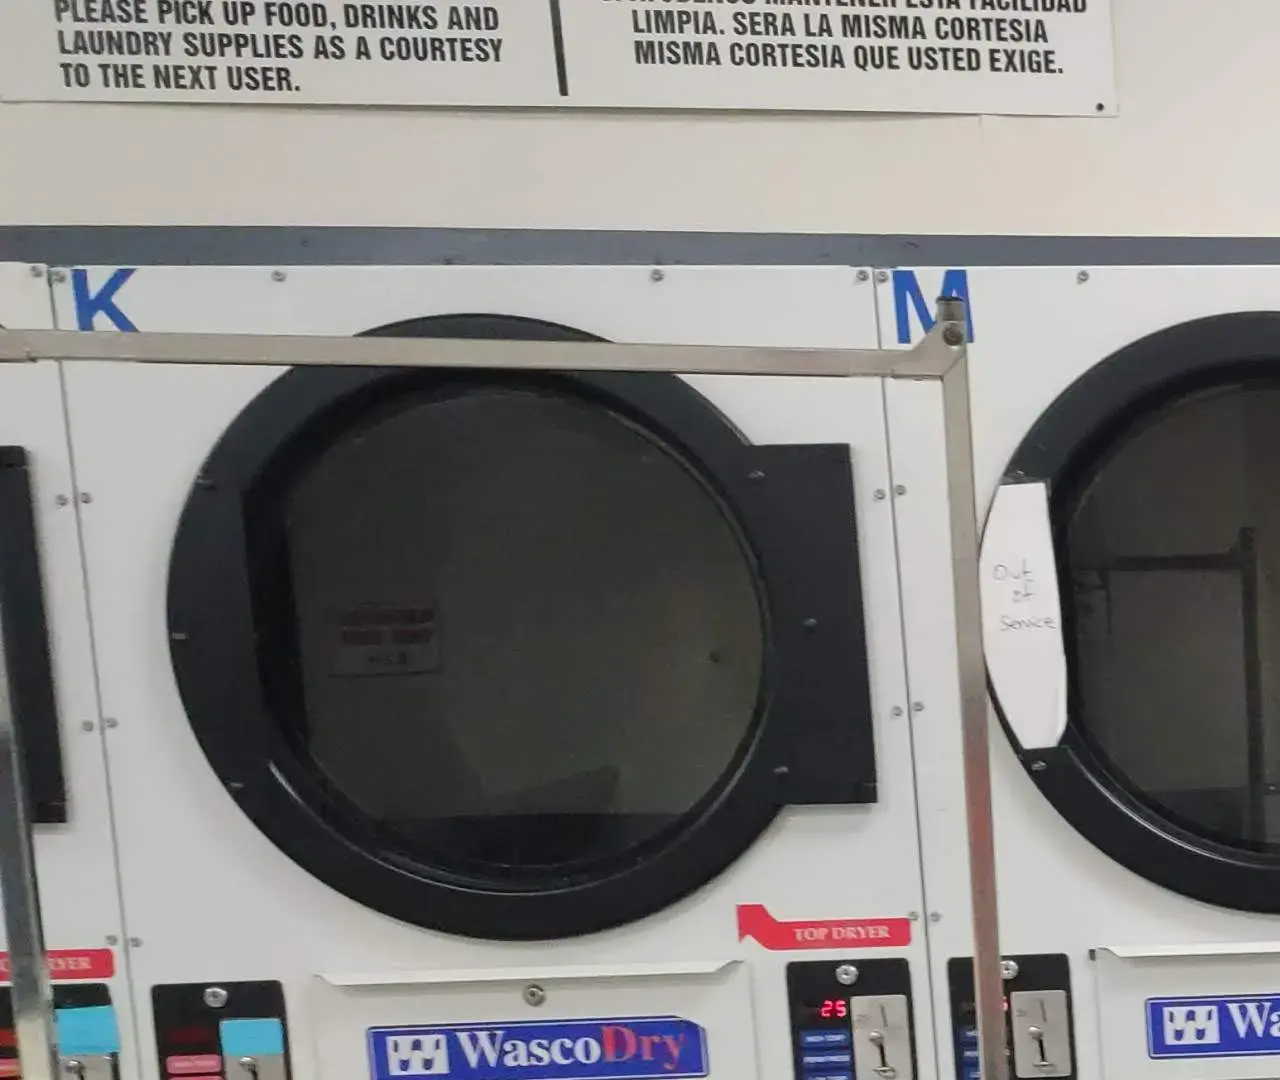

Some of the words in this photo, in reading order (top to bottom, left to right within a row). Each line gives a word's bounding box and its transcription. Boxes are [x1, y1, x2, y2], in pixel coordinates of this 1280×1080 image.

[54, 0, 148, 23] PLEASE
[157, 0, 215, 24] PICK
[222, 1, 256, 25] UP
[263, 2, 337, 30] FOOD,
[343, 4, 438, 29] DRINKS
[448, 6, 499, 30] AND
[632, 9, 725, 35] LIMPIA.
[732, 12, 796, 36] SERA
[804, 13, 833, 37] LA
[841, 15, 927, 40] MISMA
[935, 17, 1048, 43] CORTESIA
[57, 31, 173, 55] LAUNDRY
[182, 31, 304, 59] SUPPLIES
[314, 35, 346, 60] AS
[355, 36, 372, 60] A
[379, 36, 503, 62] COURTESY
[634, 40, 721, 65] MISMA
[729, 42, 845, 69] CORTESIA
[853, 45, 900, 71] QUE
[907, 47, 981, 71] USTED
[988, 49, 1063, 74] EXIGE.
[59, 63, 90, 88] TO
[97, 63, 146, 88] THE
[153, 65, 217, 90] NEXT
[226, 66, 301, 91] USER.
[70, 268, 140, 332] K
[892, 269, 974, 343] M
[993, 558, 1033, 581] Out
[793, 927, 828, 941] TOP
[833, 925, 890, 940] DRYER
[820, 999, 848, 1018] 25
[455, 1026, 686, 1070] WascoDry
